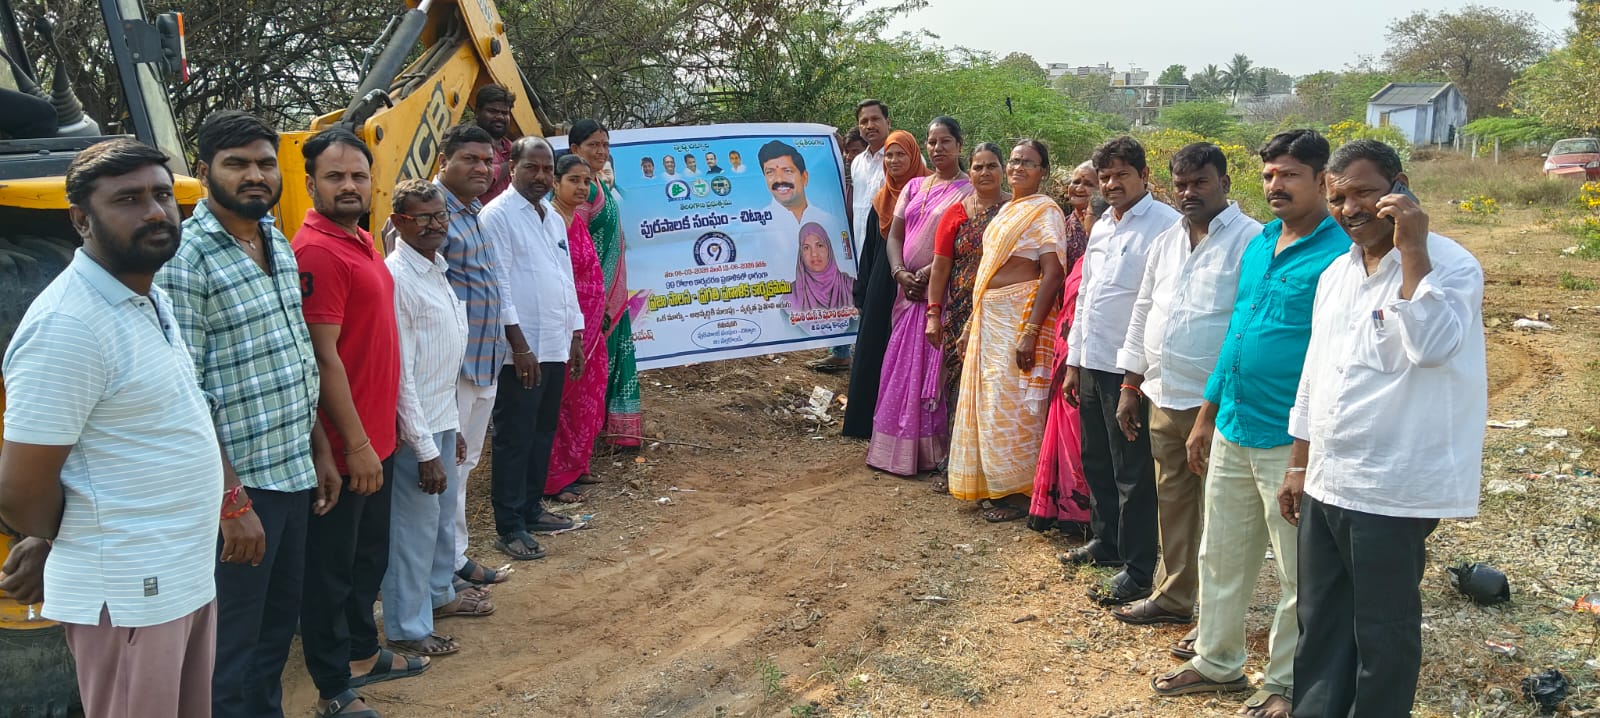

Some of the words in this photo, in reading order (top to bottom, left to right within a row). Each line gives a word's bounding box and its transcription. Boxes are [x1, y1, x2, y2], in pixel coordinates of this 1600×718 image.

[640, 214, 691, 238] పురపాలక
[693, 211, 729, 229] సంఘం
[740, 208, 772, 225] చిట్యాల
